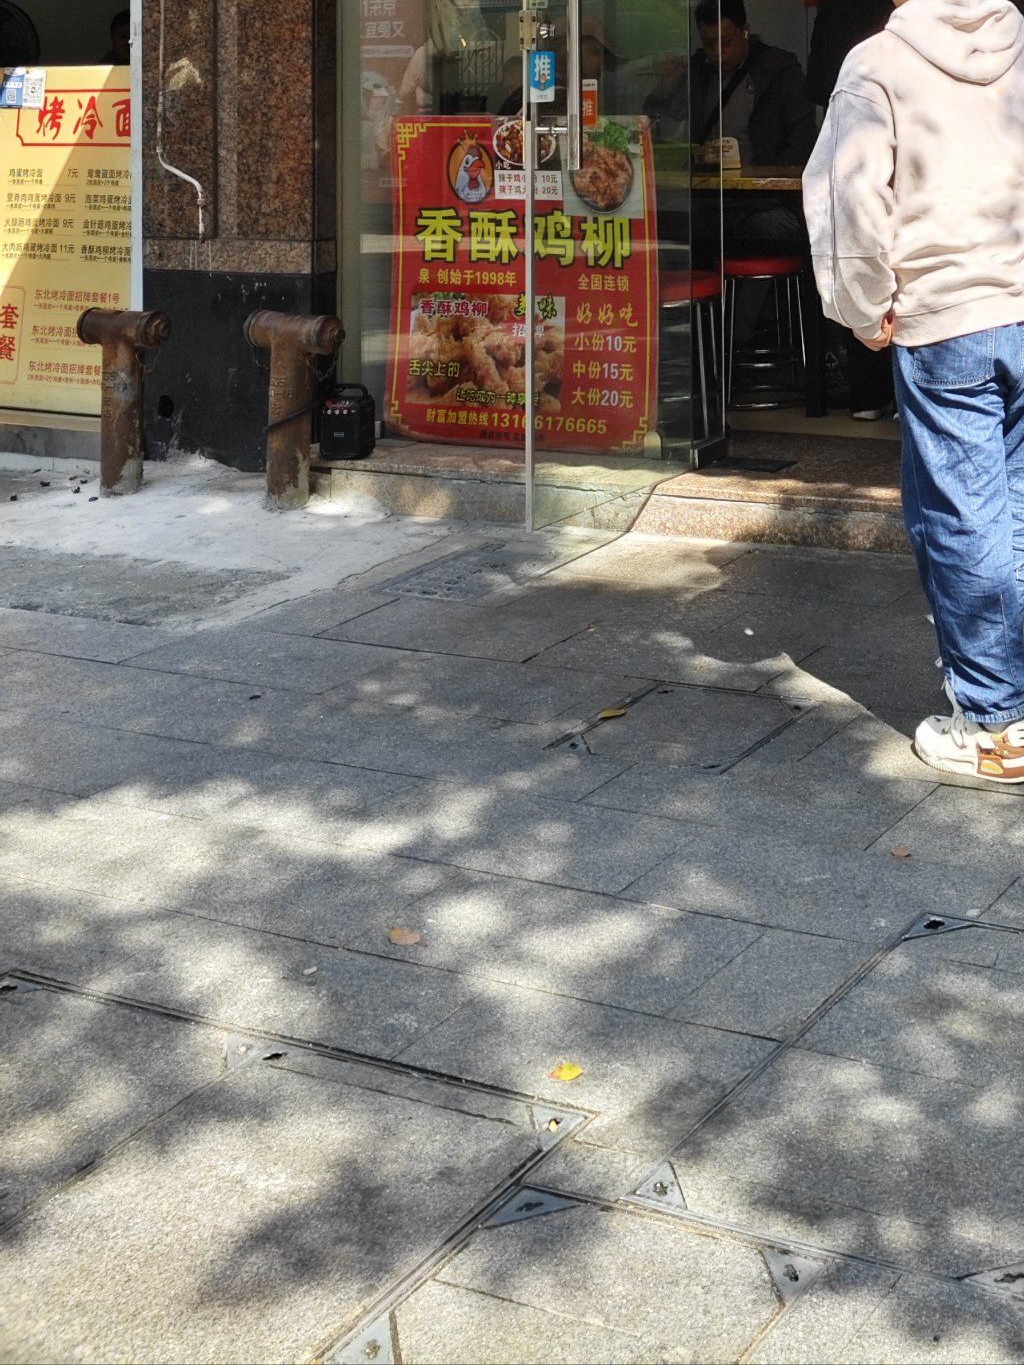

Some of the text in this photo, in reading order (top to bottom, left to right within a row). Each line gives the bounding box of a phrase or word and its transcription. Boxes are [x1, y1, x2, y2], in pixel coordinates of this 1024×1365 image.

[415, 207, 633, 269] 香酥鸡柳
[436, 269, 517, 287] 创始于1998年
[577, 273, 630, 292] 全国连锁
[419, 298, 489, 317] 香酥鸡柳
[576, 301, 638, 327] 好好吃
[0, 302, 19, 362] 套餐
[574, 332, 638, 354] 小份10元
[572, 359, 634, 382] 中份15元
[571, 386, 634, 409] 大份20元
[425, 408, 489, 427] 财富加盟热线
